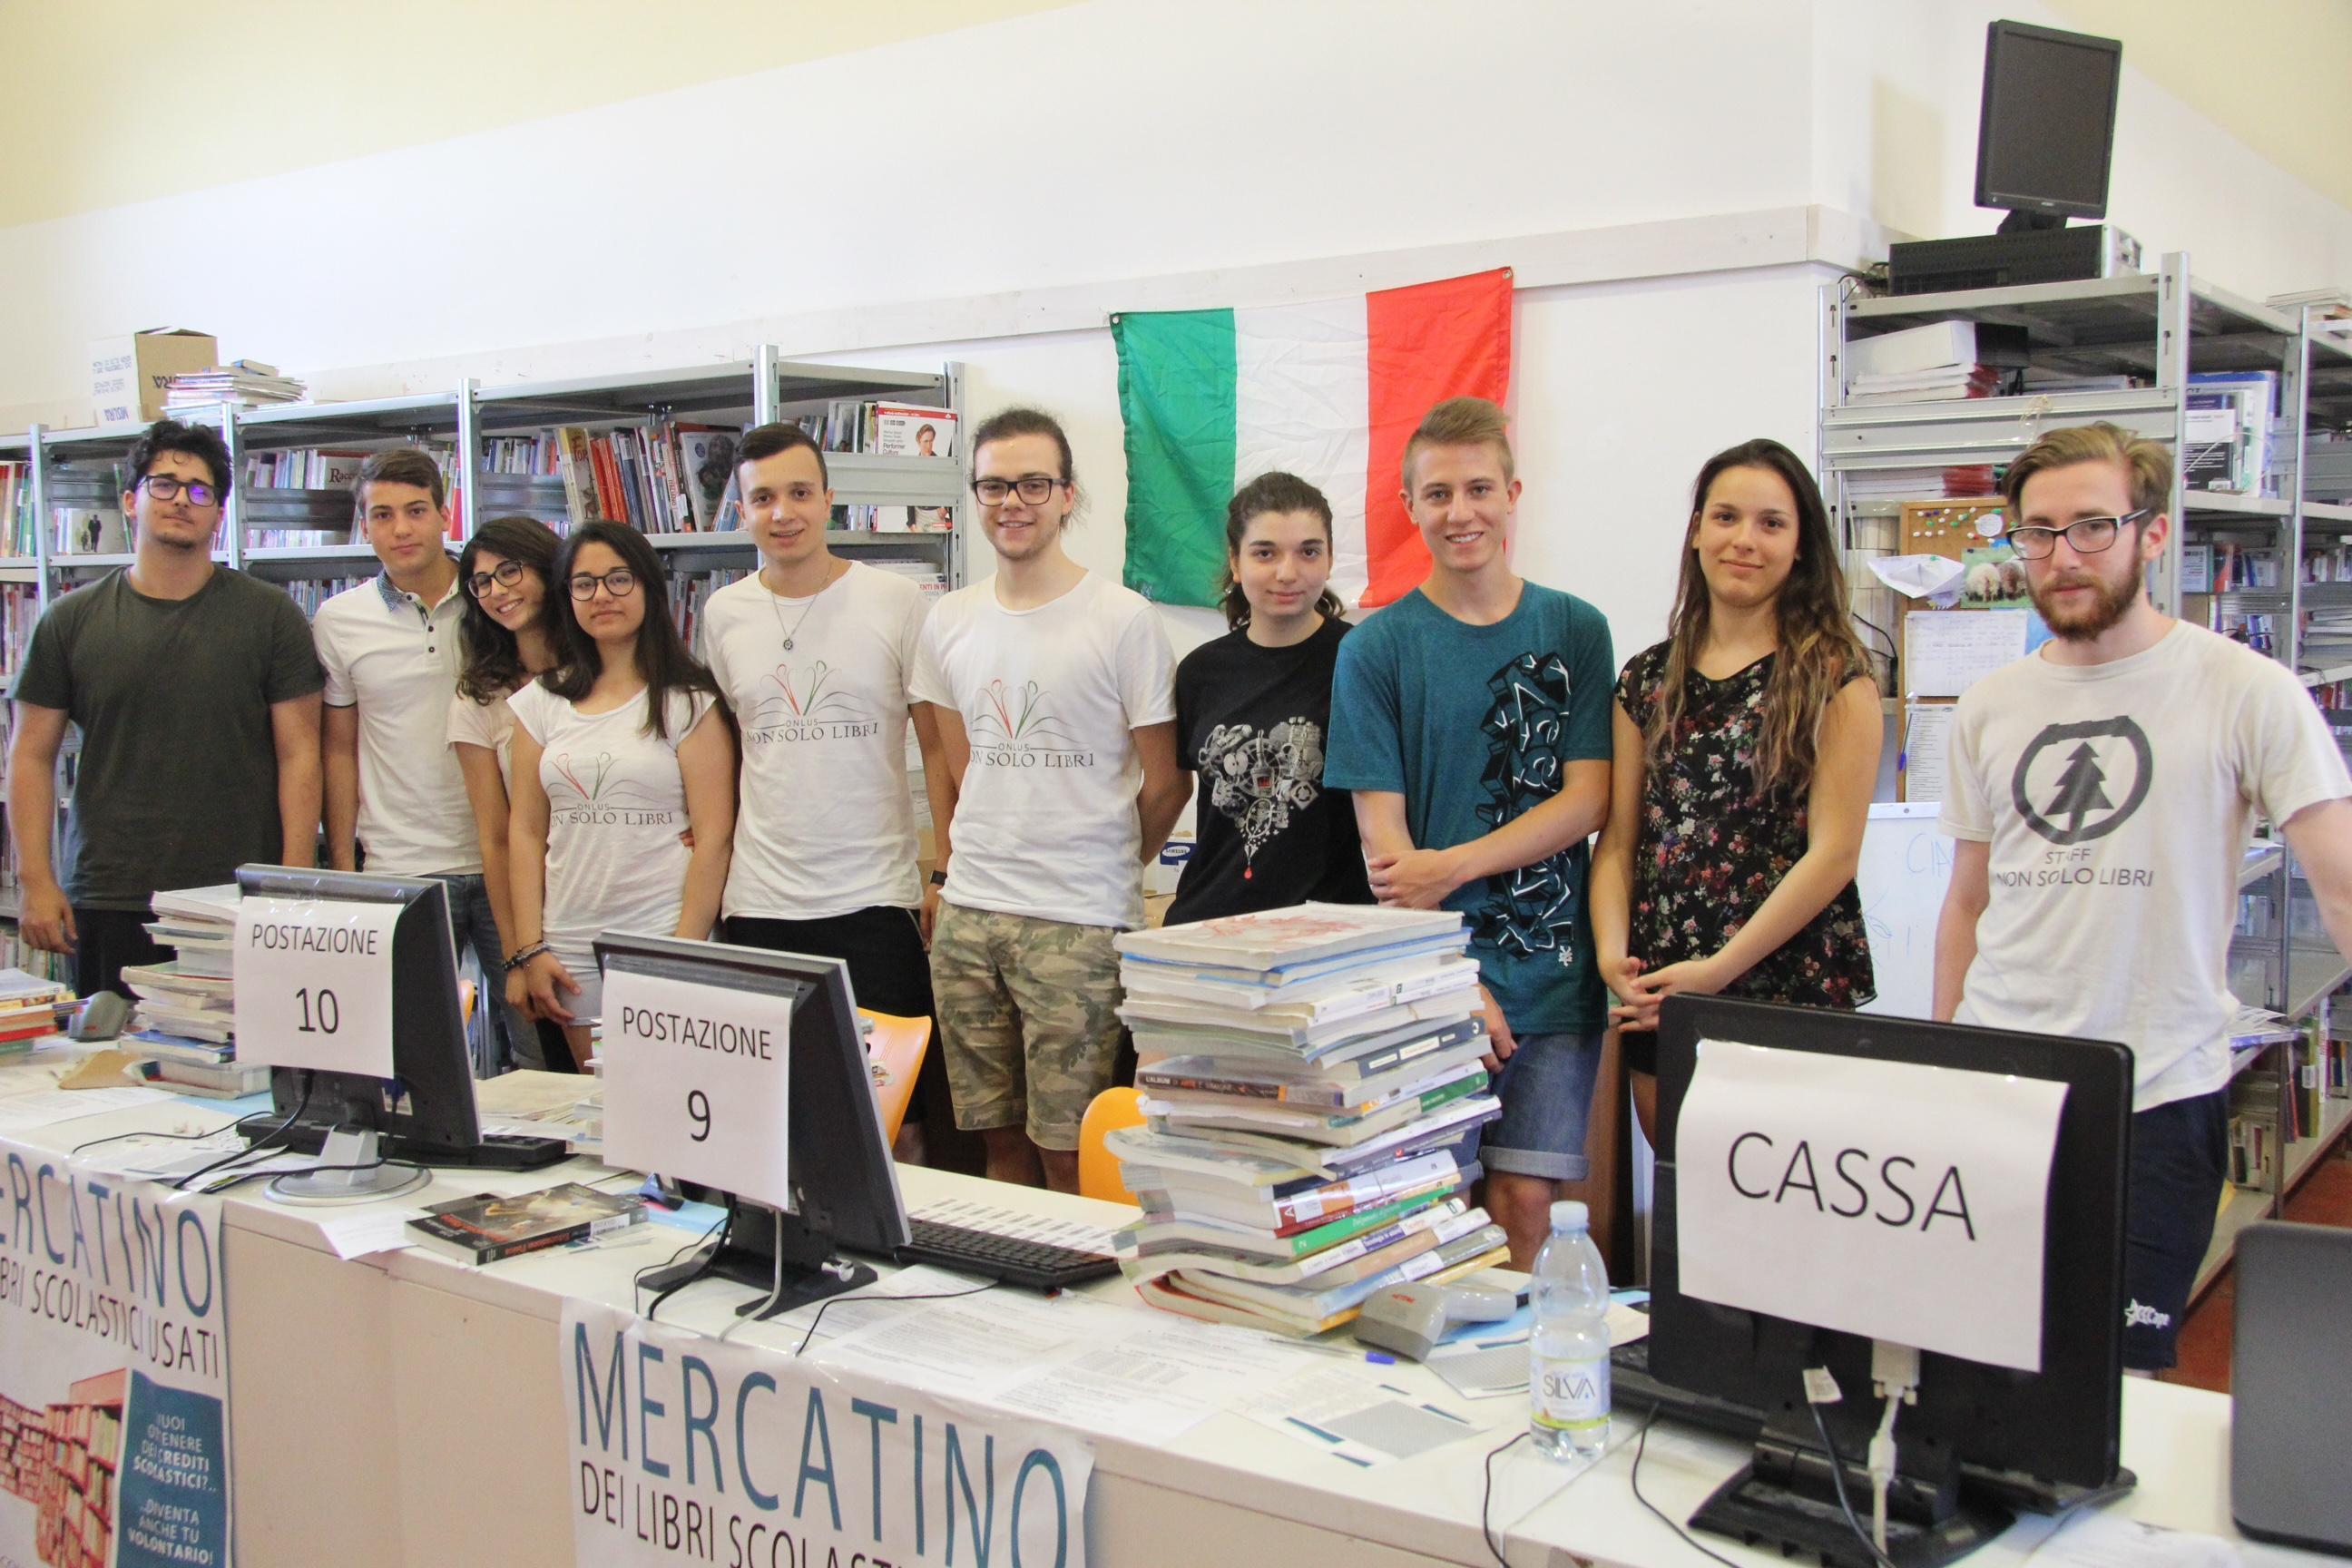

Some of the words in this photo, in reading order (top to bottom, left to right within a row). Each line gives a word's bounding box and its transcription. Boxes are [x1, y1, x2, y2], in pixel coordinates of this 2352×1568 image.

[777, 727, 825, 742] SOLO
[833, 722, 878, 739] LIBRI
[786, 718, 818, 727] ONLUS
[986, 751, 1035, 768] SOLO
[1045, 753, 1094, 768] LIBRI
[998, 743, 1030, 751] ONLUS
[569, 811, 617, 826] SOLO
[625, 811, 673, 826] LIBRI
[577, 803, 611, 811] ONLUS
[2037, 867, 2094, 887] SOLO
[2100, 868, 2154, 887] LIBRI
[251, 924, 378, 956] POSTAZIONE
[296, 987, 339, 1034] 10
[622, 1006, 772, 1061] POSTAZIONE
[687, 1089, 711, 1142] 9
[1728, 1132, 1975, 1241] CASSA
[0, 1152, 212, 1318] RCATINO
[31, 1269, 143, 1355] SCOLASTICI
[149, 1315, 219, 1379] USATI
[1543, 1375, 1595, 1399] SILVA
[574, 1321, 1069, 1568] MERCATINO
[581, 1460, 625, 1530] DEI
[636, 1481, 715, 1563] LIBRI
[181, 1525, 201, 1544] TU
